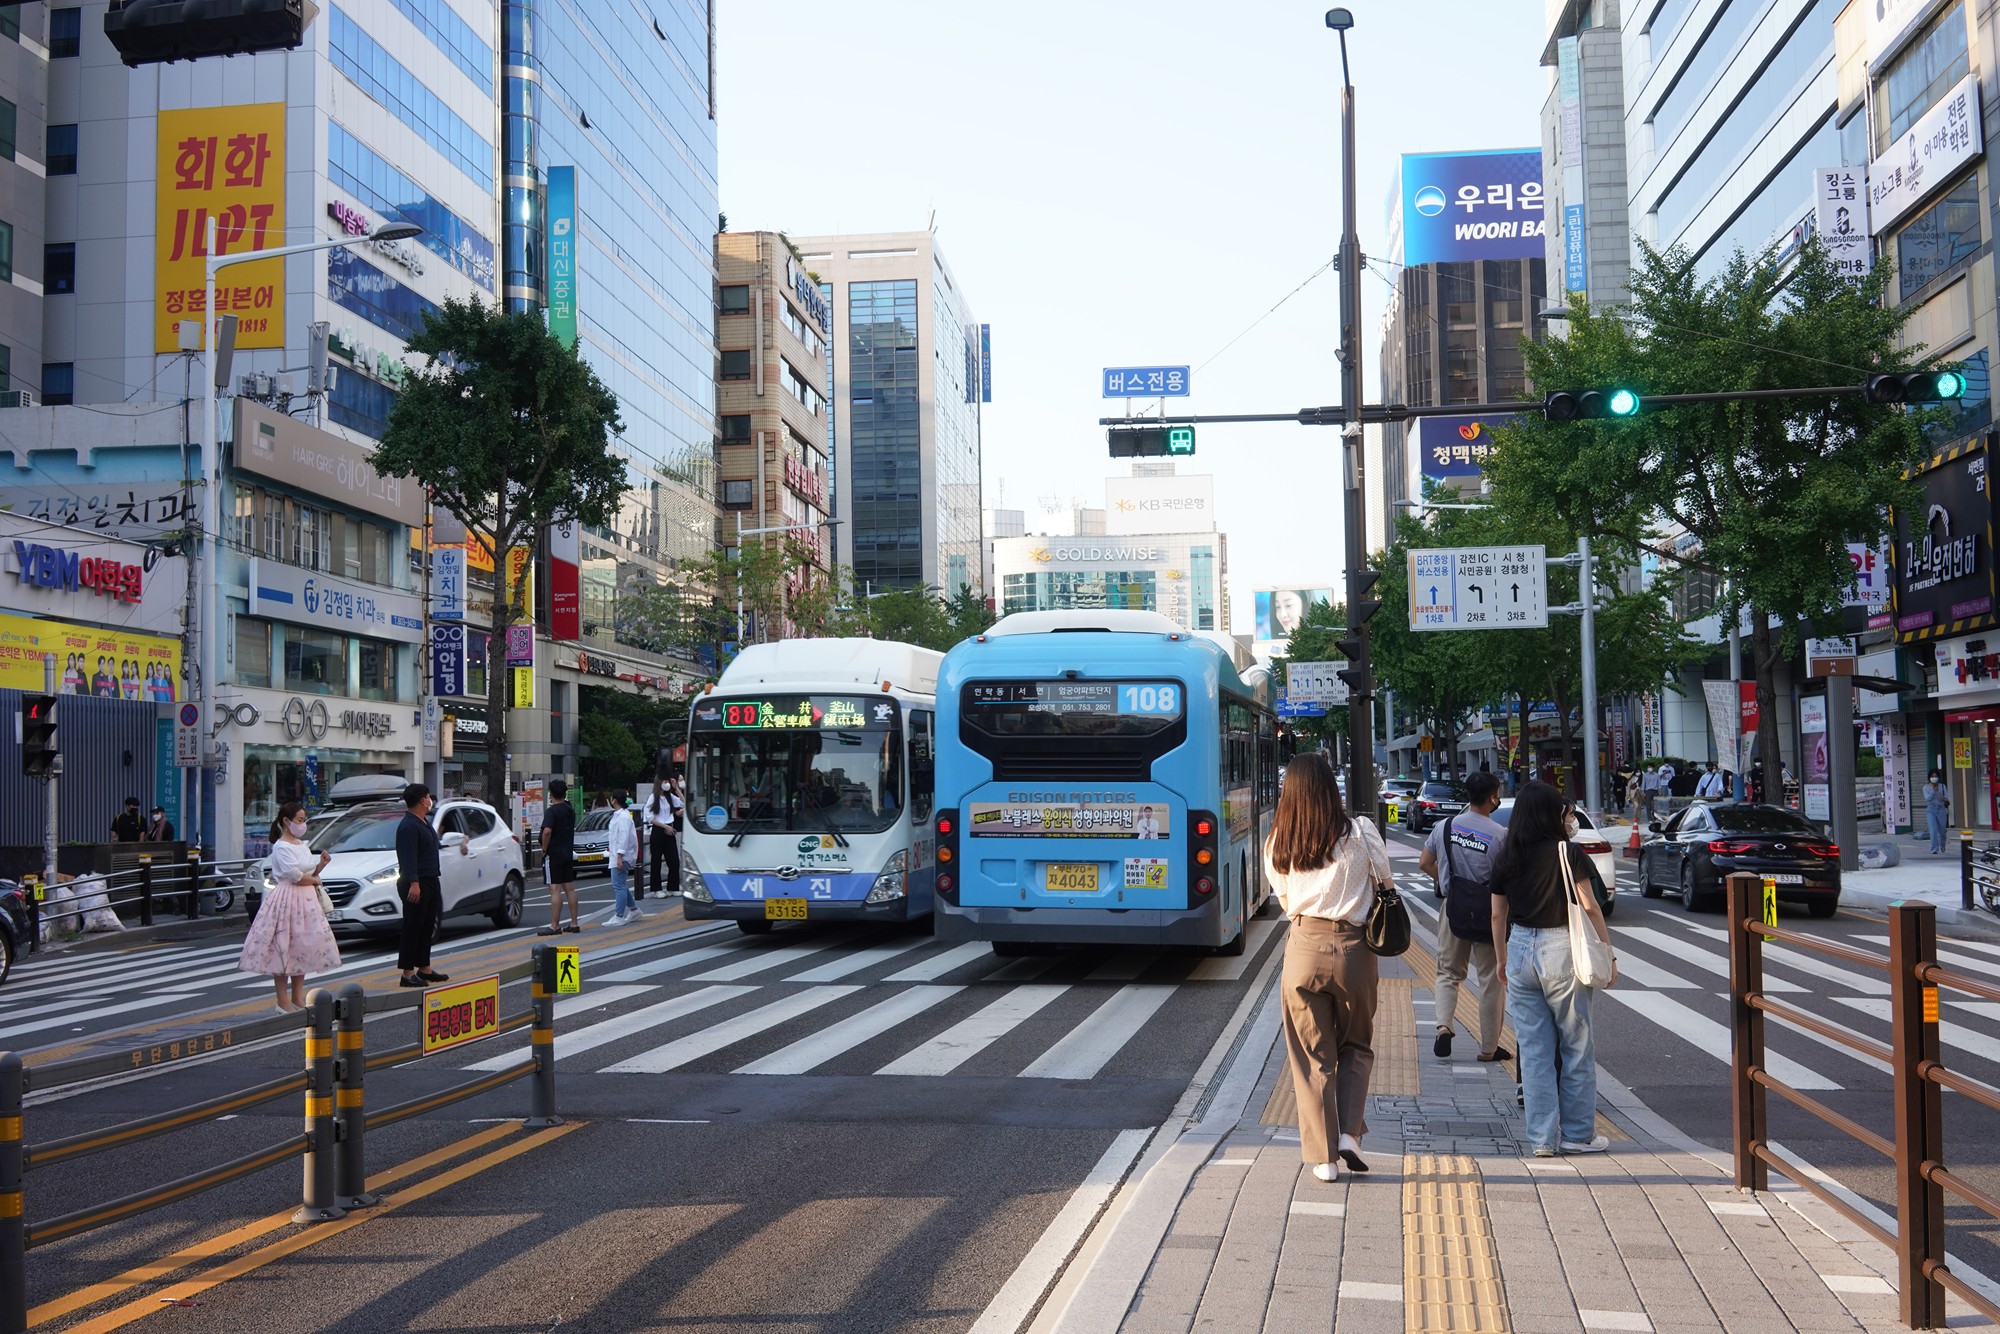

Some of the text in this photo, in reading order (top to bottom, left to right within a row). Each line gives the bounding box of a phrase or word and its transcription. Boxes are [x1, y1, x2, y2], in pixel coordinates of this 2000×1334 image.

[1947, 93, 1967, 126] 전문
[1949, 121, 1969, 153] 학원
[175, 133, 271, 190] 회화
[1826, 173, 1856, 187] 킹스
[168, 204, 275, 261] JLPT
[1455, 222, 1517, 241] WOORI
[1568, 207, 1582, 264] 그린컴퓨터
[553, 240, 571, 319] 대신증권
[166, 285, 274, 314] 정훈일본어
[1109, 371, 1184, 393] 버스전용
[293, 446, 315, 468] HAIR
[1976, 475, 1985, 492] 2F
[1140, 497, 1205, 511] KB 국민은행
[1056, 547, 1158, 562] GOLD & WISE
[1417, 554, 1448, 565] BRT중앙
[1932, 533, 1976, 584] 운전면허
[13, 539, 80, 593] YBM
[438, 565, 460, 575] 김정일
[1417, 566, 1448, 577] 버스전용
[1458, 565, 1493, 577] 시민공원
[1501, 564, 1529, 575] 경찰청
[80, 557, 143, 604] 어학원
[441, 576, 457, 609] 치과
[323, 588, 354, 620] 김정일
[356, 596, 376, 623] 치과
[1426, 614, 1445, 623] 1차로
[1467, 612, 1487, 622] 2차로
[1507, 611, 1527, 622] 3차로
[439, 652, 457, 694] 안경
[1058, 686, 1112, 696] 엄궁아파트단지
[1125, 687, 1176, 711] 108
[728, 705, 756, 725] 80
[1095, 704, 1111, 712] 2801
[343, 710, 392, 737] 아이뱅크
[1008, 792, 1137, 804] EDISON MOTORS
[1002, 808, 1042, 827] 노블레스
[1042, 808, 1073, 828] 홍인식
[1073, 808, 1134, 828] 성형외과의원
[800, 840, 819, 848] CNG
[797, 853, 848, 868] 천연가스버스
[1074, 865, 1086, 873] 70
[742, 878, 763, 898] 세
[810, 878, 832, 899] 진
[1058, 874, 1096, 888] 4043
[776, 906, 806, 918] 3155
[427, 995, 496, 1043] 무단횡단 금지
[131, 1030, 232, 1067] 무단횡단금지
